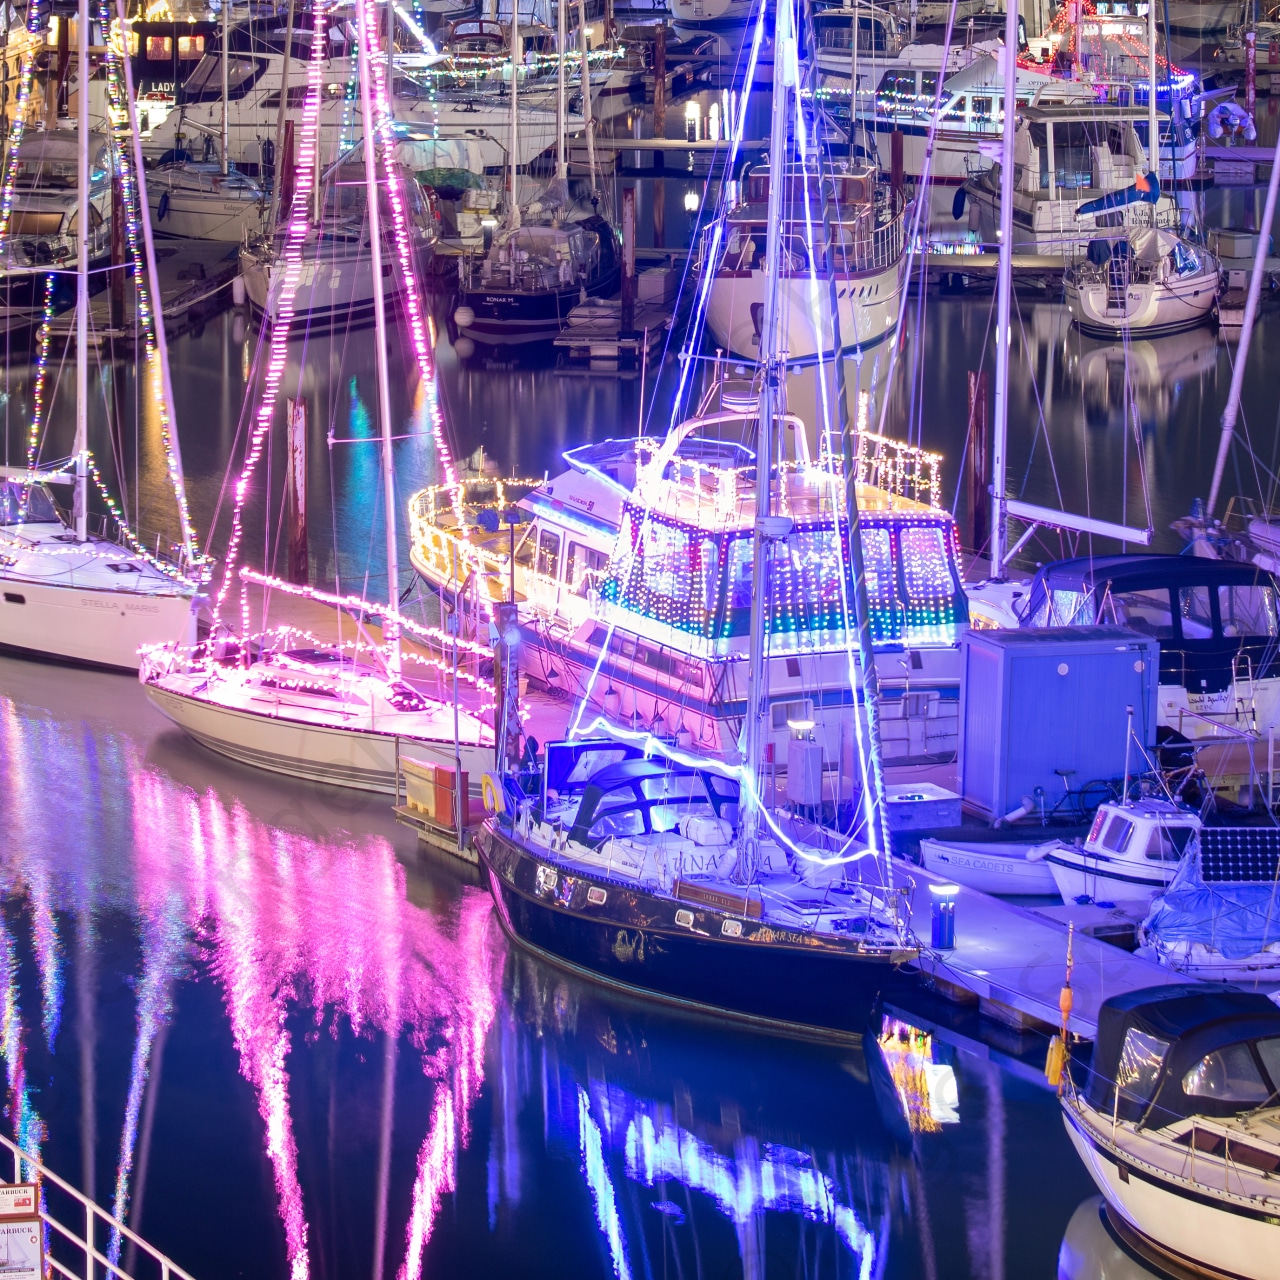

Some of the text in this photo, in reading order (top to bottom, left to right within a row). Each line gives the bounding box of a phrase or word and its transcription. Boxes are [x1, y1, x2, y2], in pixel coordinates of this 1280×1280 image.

[151, 82, 176, 92] LADY
[81, 598, 160, 613] STELLA MARIS
[951, 856, 1014, 873] SEA CADETS
